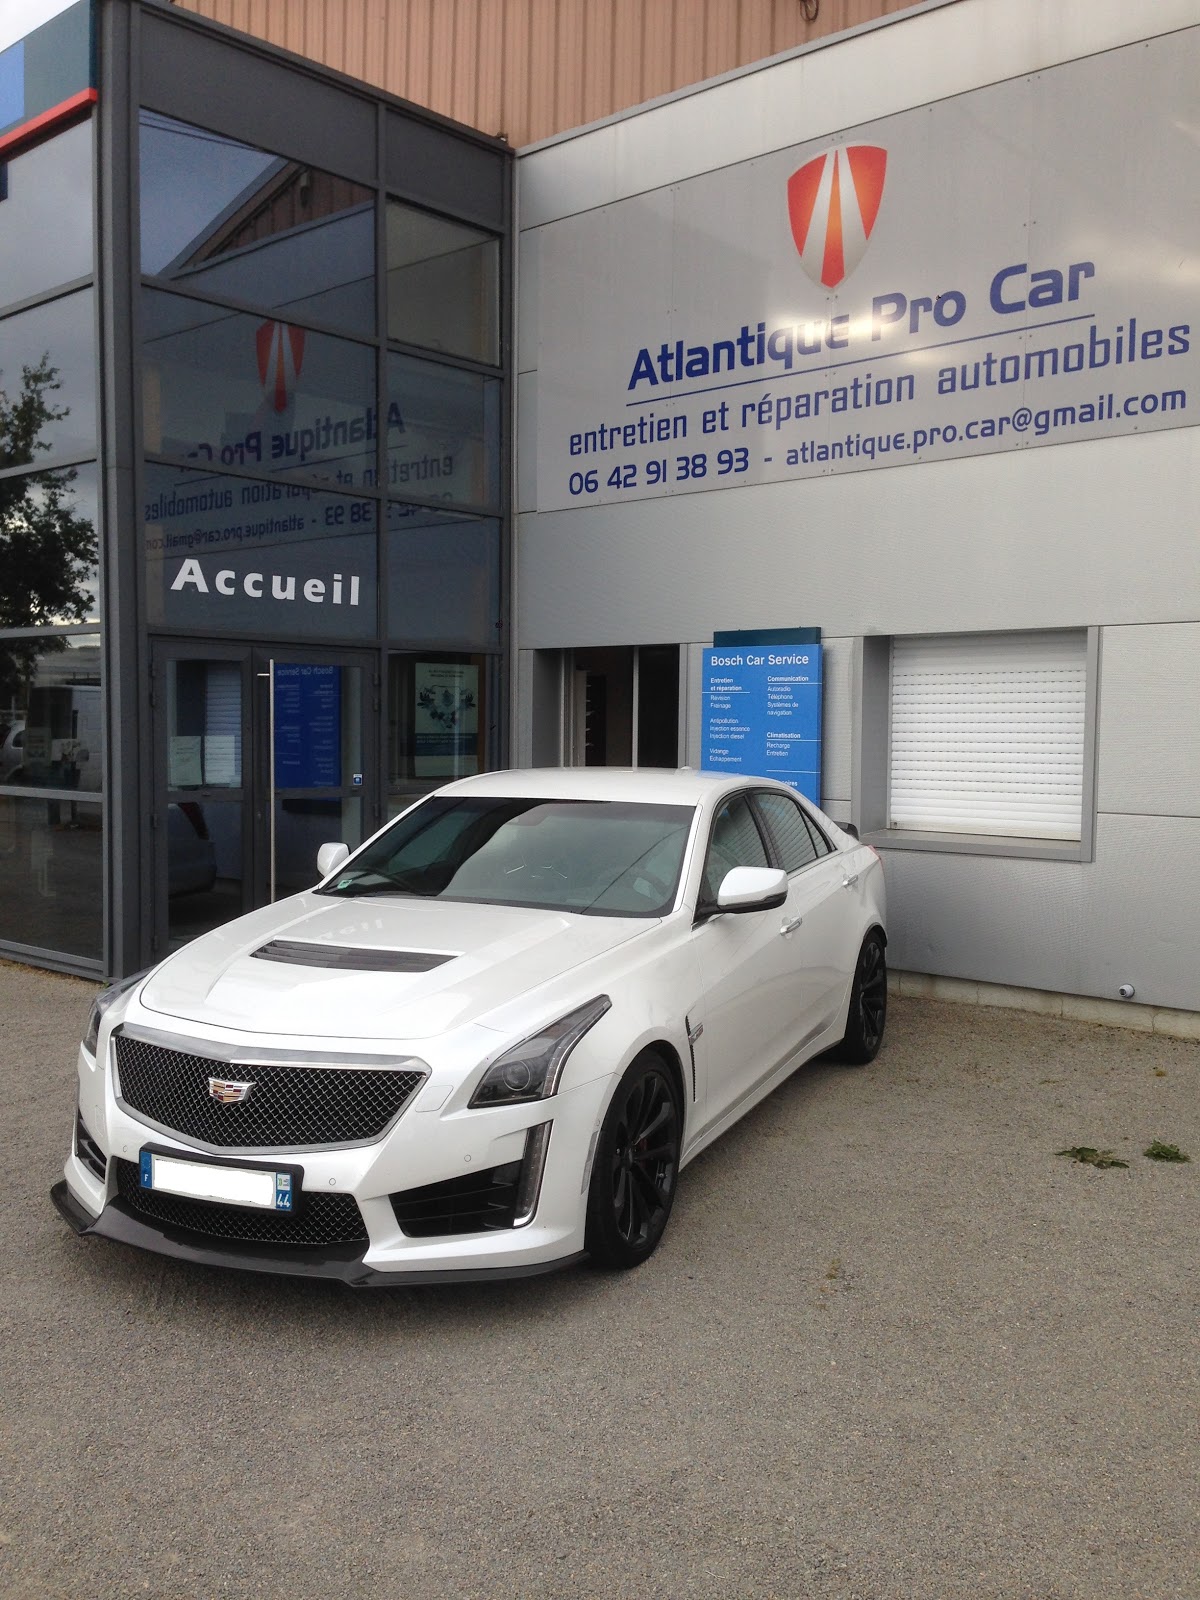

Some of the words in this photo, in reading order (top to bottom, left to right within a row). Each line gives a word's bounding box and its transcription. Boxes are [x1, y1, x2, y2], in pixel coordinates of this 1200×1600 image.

[626, 314, 850, 391] Atlantique
[871, 290, 967, 342] Pro
[989, 261, 1095, 315] Car
[569, 412, 687, 456] entretien
[702, 401, 729, 434] et
[741, 372, 915, 431] réparation
[937, 317, 1190, 395] automobiles
[569, 469, 599, 496] 06
[607, 464, 637, 490] 42
[645, 459, 667, 485] 91
[676, 453, 708, 481] 38
[717, 447, 750, 475] 93
[785, 389, 1187, 466] atlantique.pro.car@gmail.com
[170, 558, 360, 606] Accueil
[711, 655, 743, 666] Bosch
[746, 654, 765, 666] Car
[768, 653, 809, 665] Service
[766, 731, 801, 739] Climatisation
[144, 1173, 149, 1182] F
[277, 1193, 291, 1208] 44
